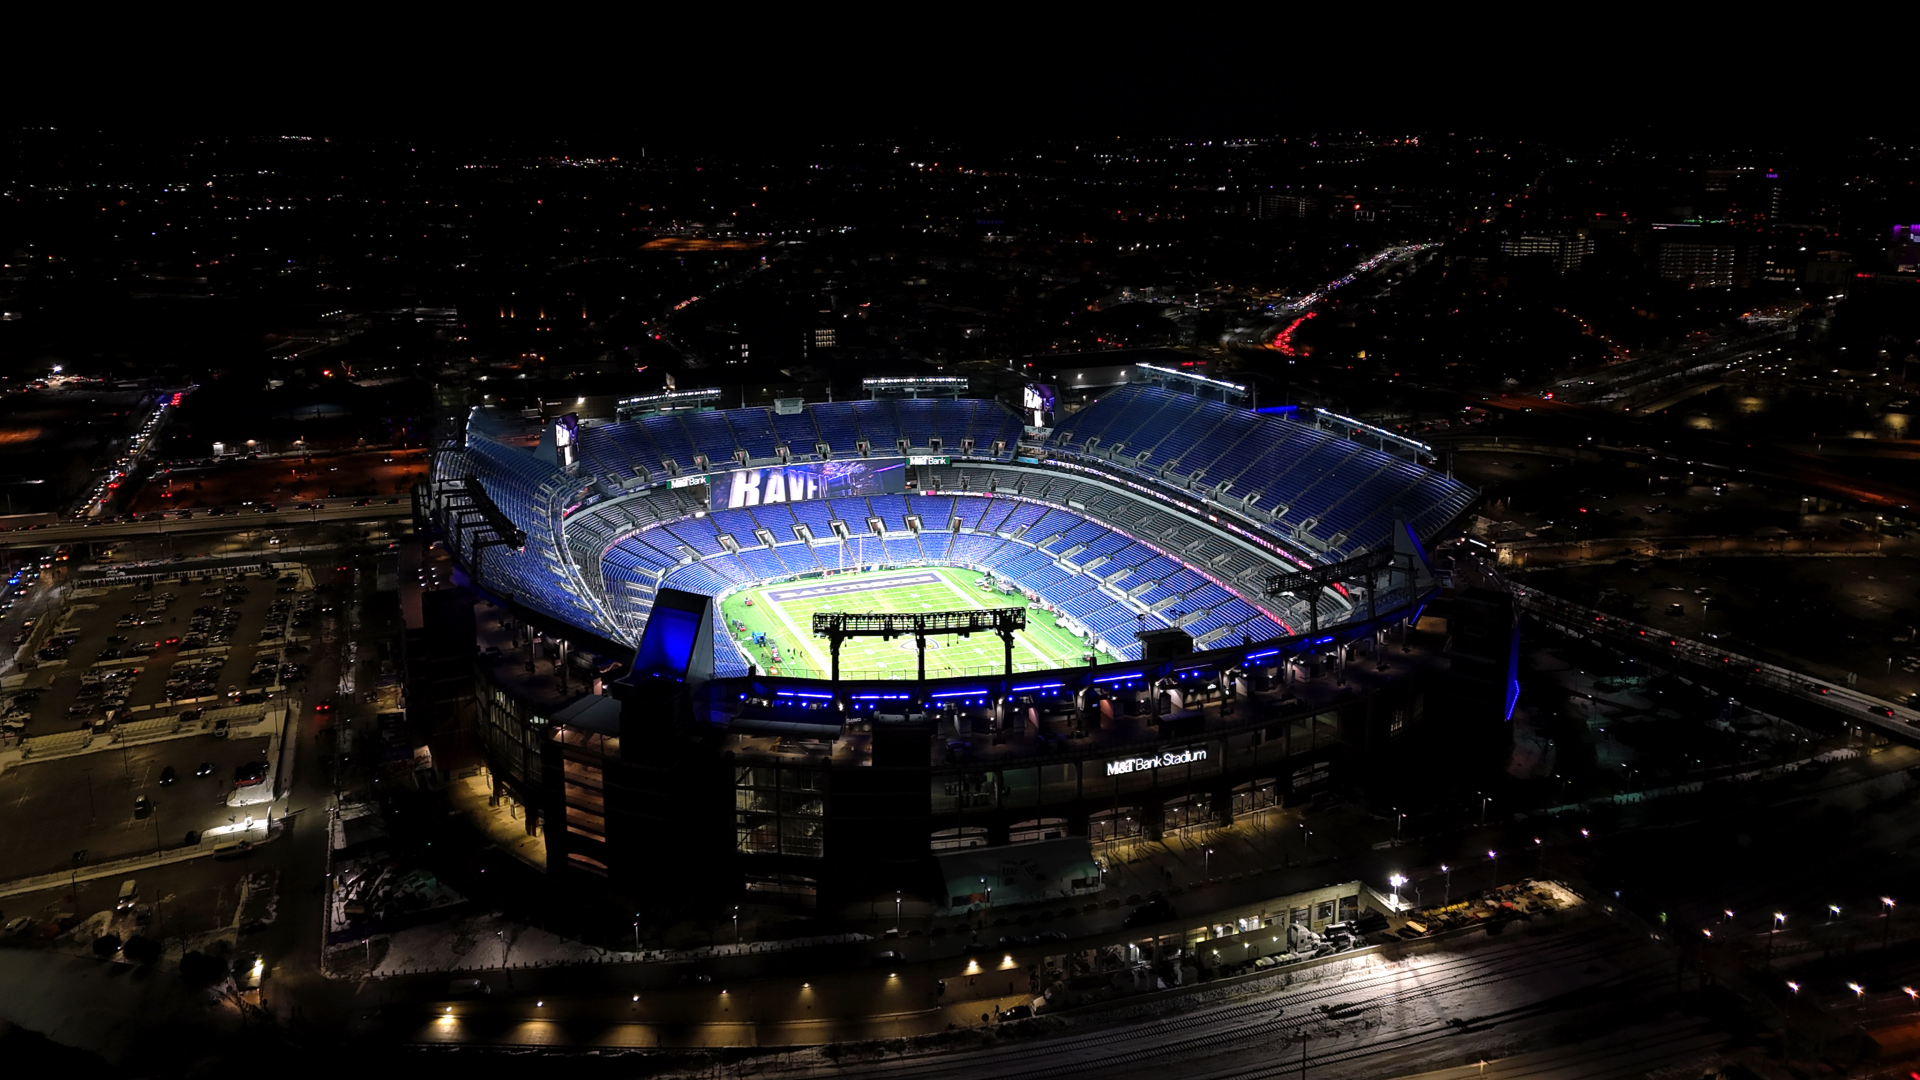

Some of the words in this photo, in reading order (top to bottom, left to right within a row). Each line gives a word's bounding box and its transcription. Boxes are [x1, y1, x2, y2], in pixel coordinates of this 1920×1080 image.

[928, 456, 946, 465] Bank
[689, 475, 707, 485] Bank
[1107, 758, 1135, 776] M&T
[1135, 755, 1162, 771] Bank
[1162, 750, 1207, 766] Stadium
